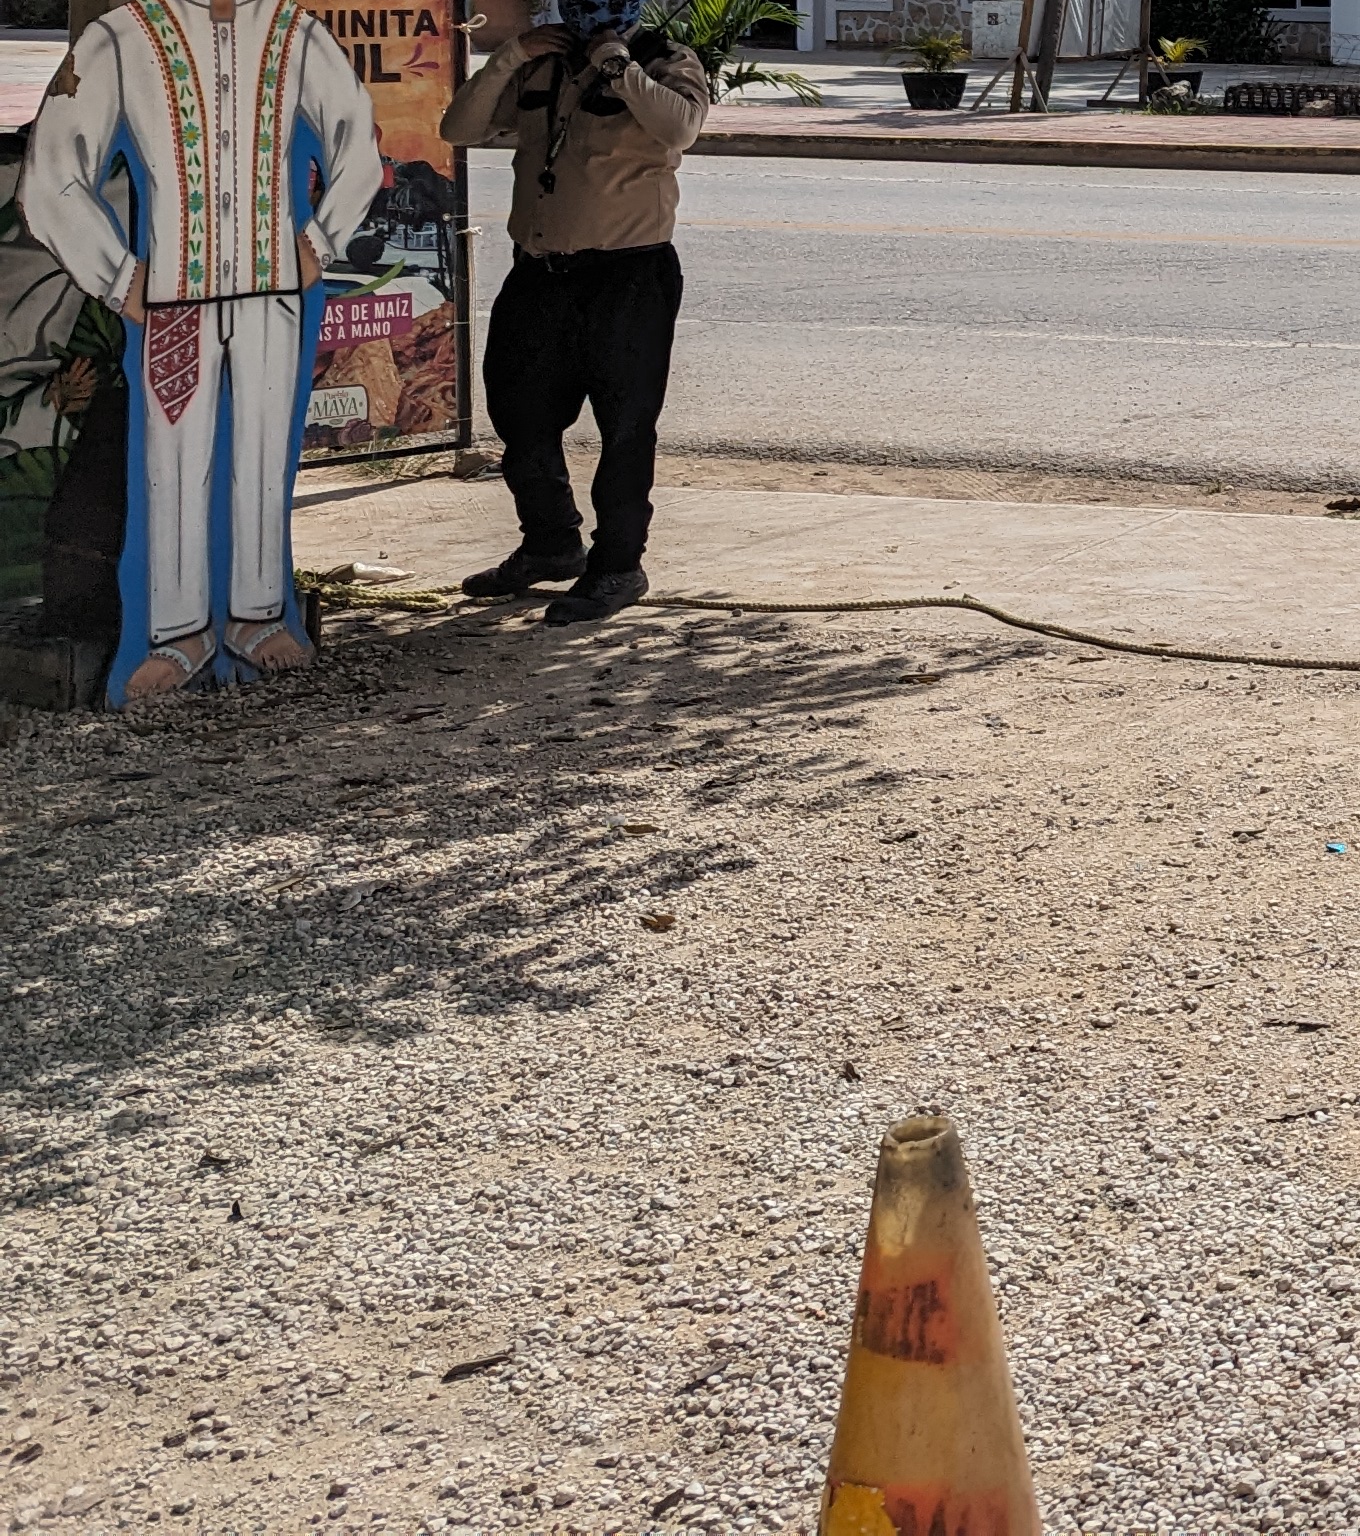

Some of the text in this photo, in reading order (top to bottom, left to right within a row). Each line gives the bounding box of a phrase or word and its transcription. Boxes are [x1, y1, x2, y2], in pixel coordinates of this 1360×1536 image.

[351, 303, 369, 321] DE
[373, 297, 410, 319] MAÍZ
[337, 325, 346, 340] A
[351, 321, 391, 339] MANO
[313, 397, 358, 418] MAYA
